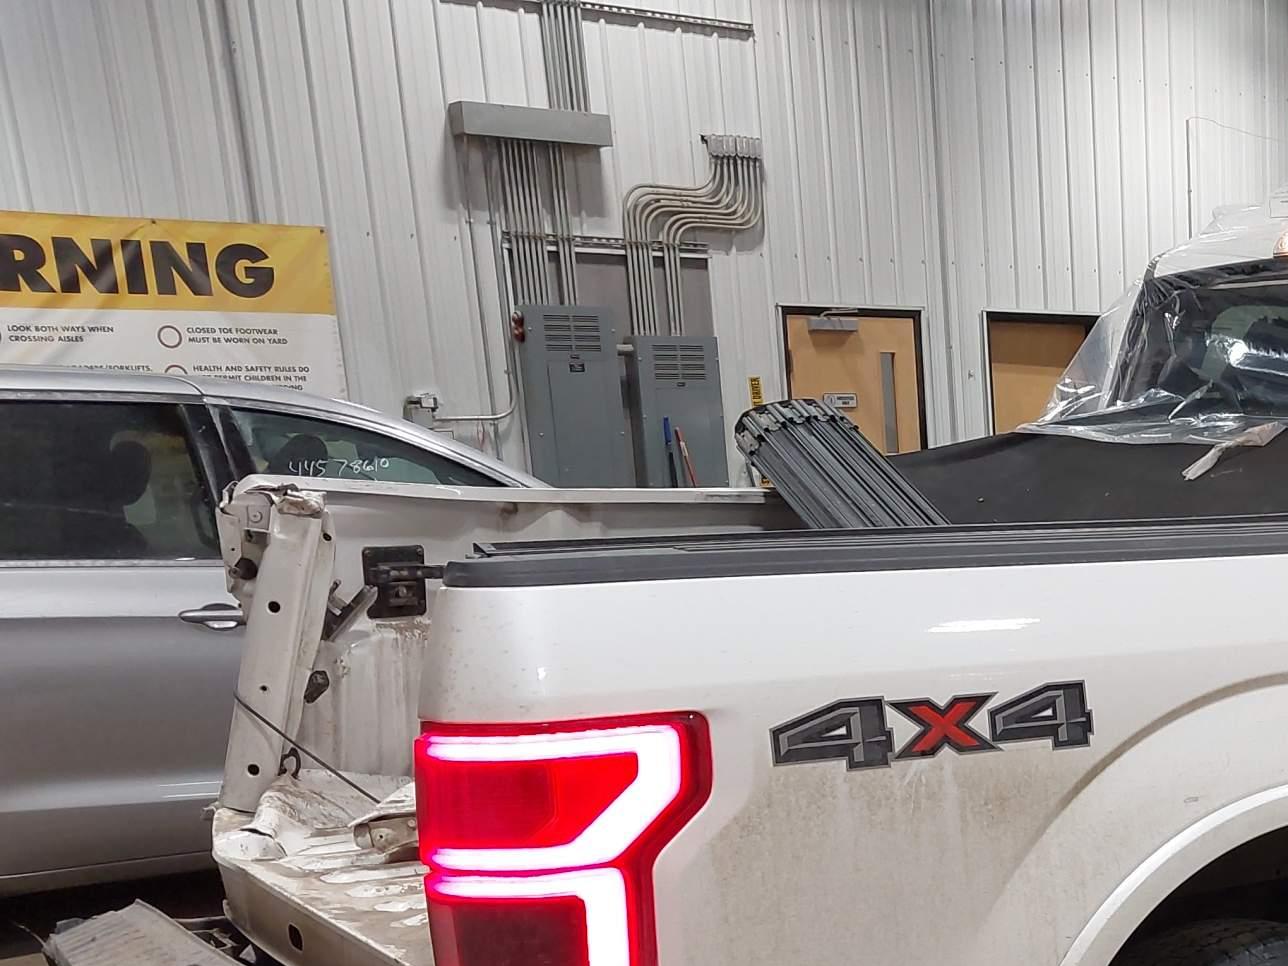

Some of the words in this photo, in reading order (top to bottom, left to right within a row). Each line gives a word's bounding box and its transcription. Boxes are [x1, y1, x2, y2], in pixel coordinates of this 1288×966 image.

[0, 234, 274, 298] RNING
[7, 324, 32, 332] LOOK
[34, 325, 58, 333] BOTH
[61, 325, 86, 333] WAYS
[218, 327, 233, 335] TOE
[57, 335, 84, 343] AISLES
[193, 365, 223, 373] HEALTH
[225, 365, 243, 373] AND
[245, 365, 272, 373] SAFETY
